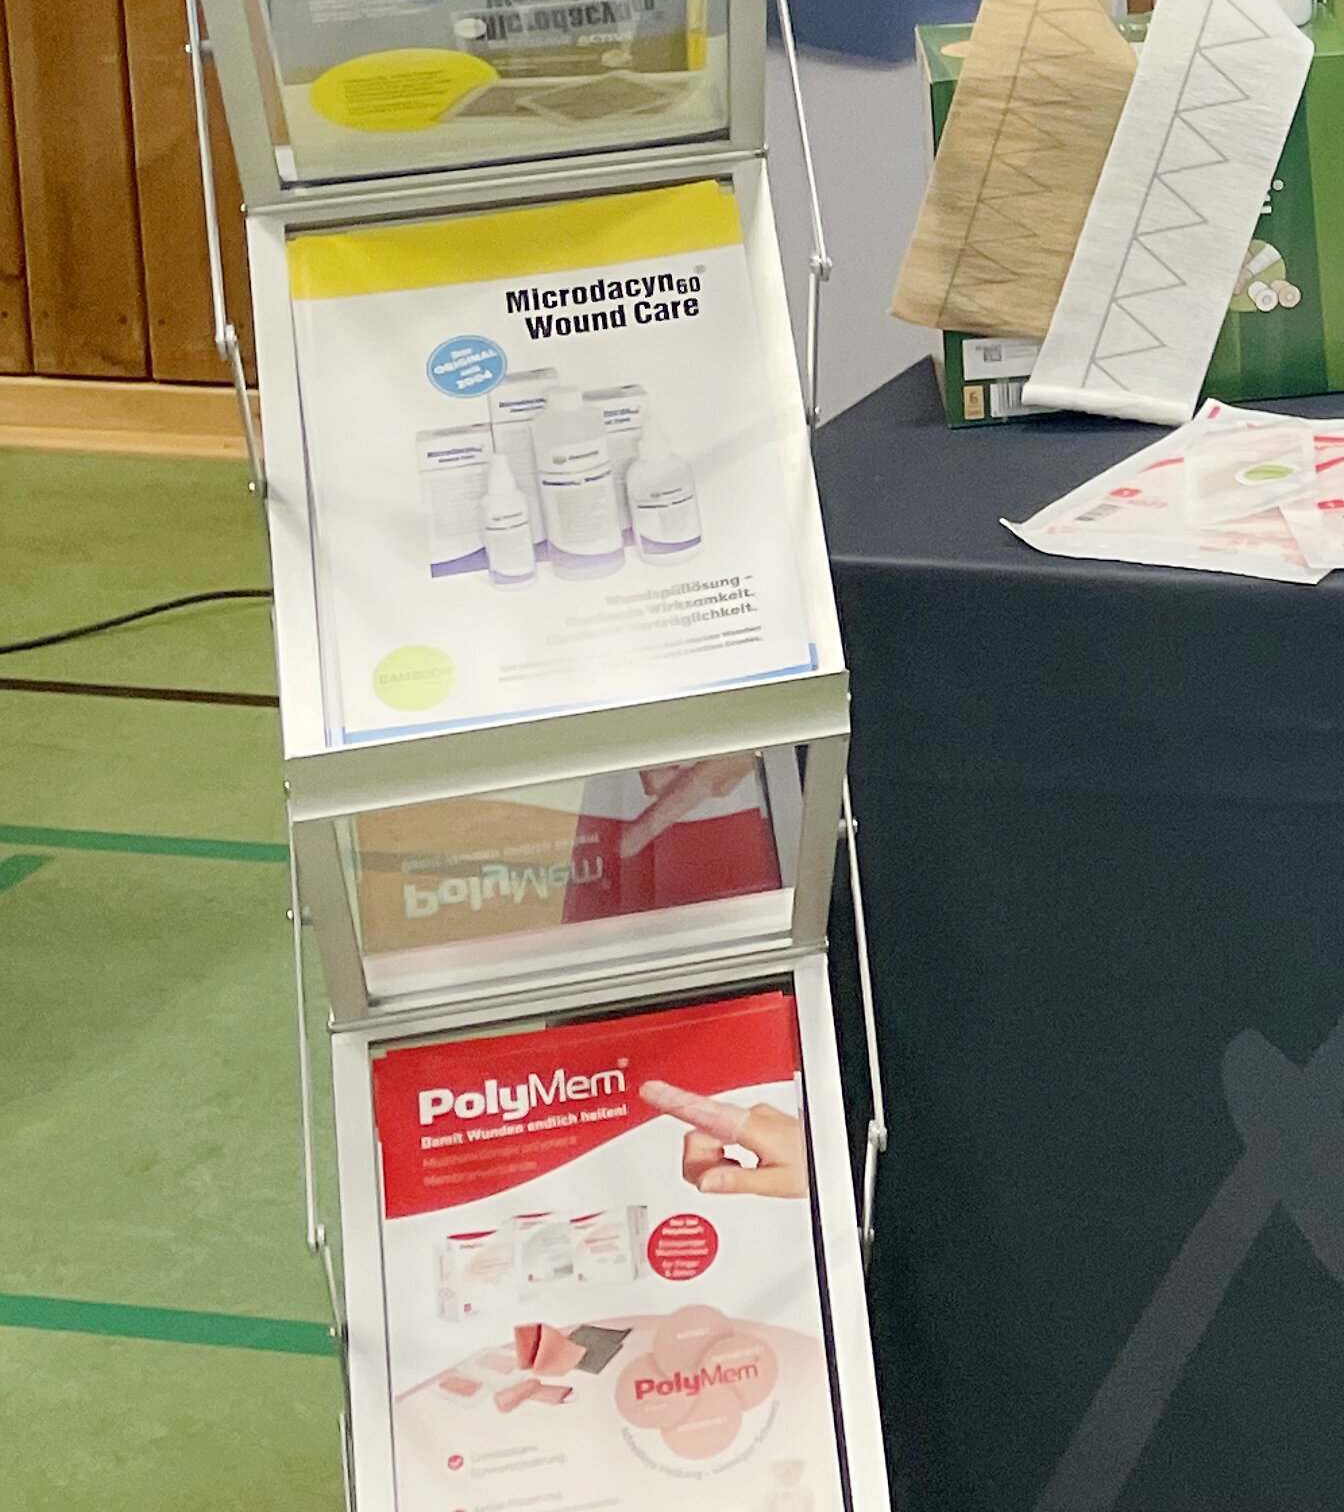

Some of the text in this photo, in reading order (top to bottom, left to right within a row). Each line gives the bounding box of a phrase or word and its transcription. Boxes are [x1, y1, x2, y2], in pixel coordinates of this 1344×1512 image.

[525, 296, 700, 340] Wound Care
[418, 1068, 627, 1126] PolyMem
[421, 1133, 463, 1150] Damit
[467, 1123, 524, 1143] Wunden
[527, 1113, 578, 1133] endlich
[634, 1362, 760, 1400] PolyMem
